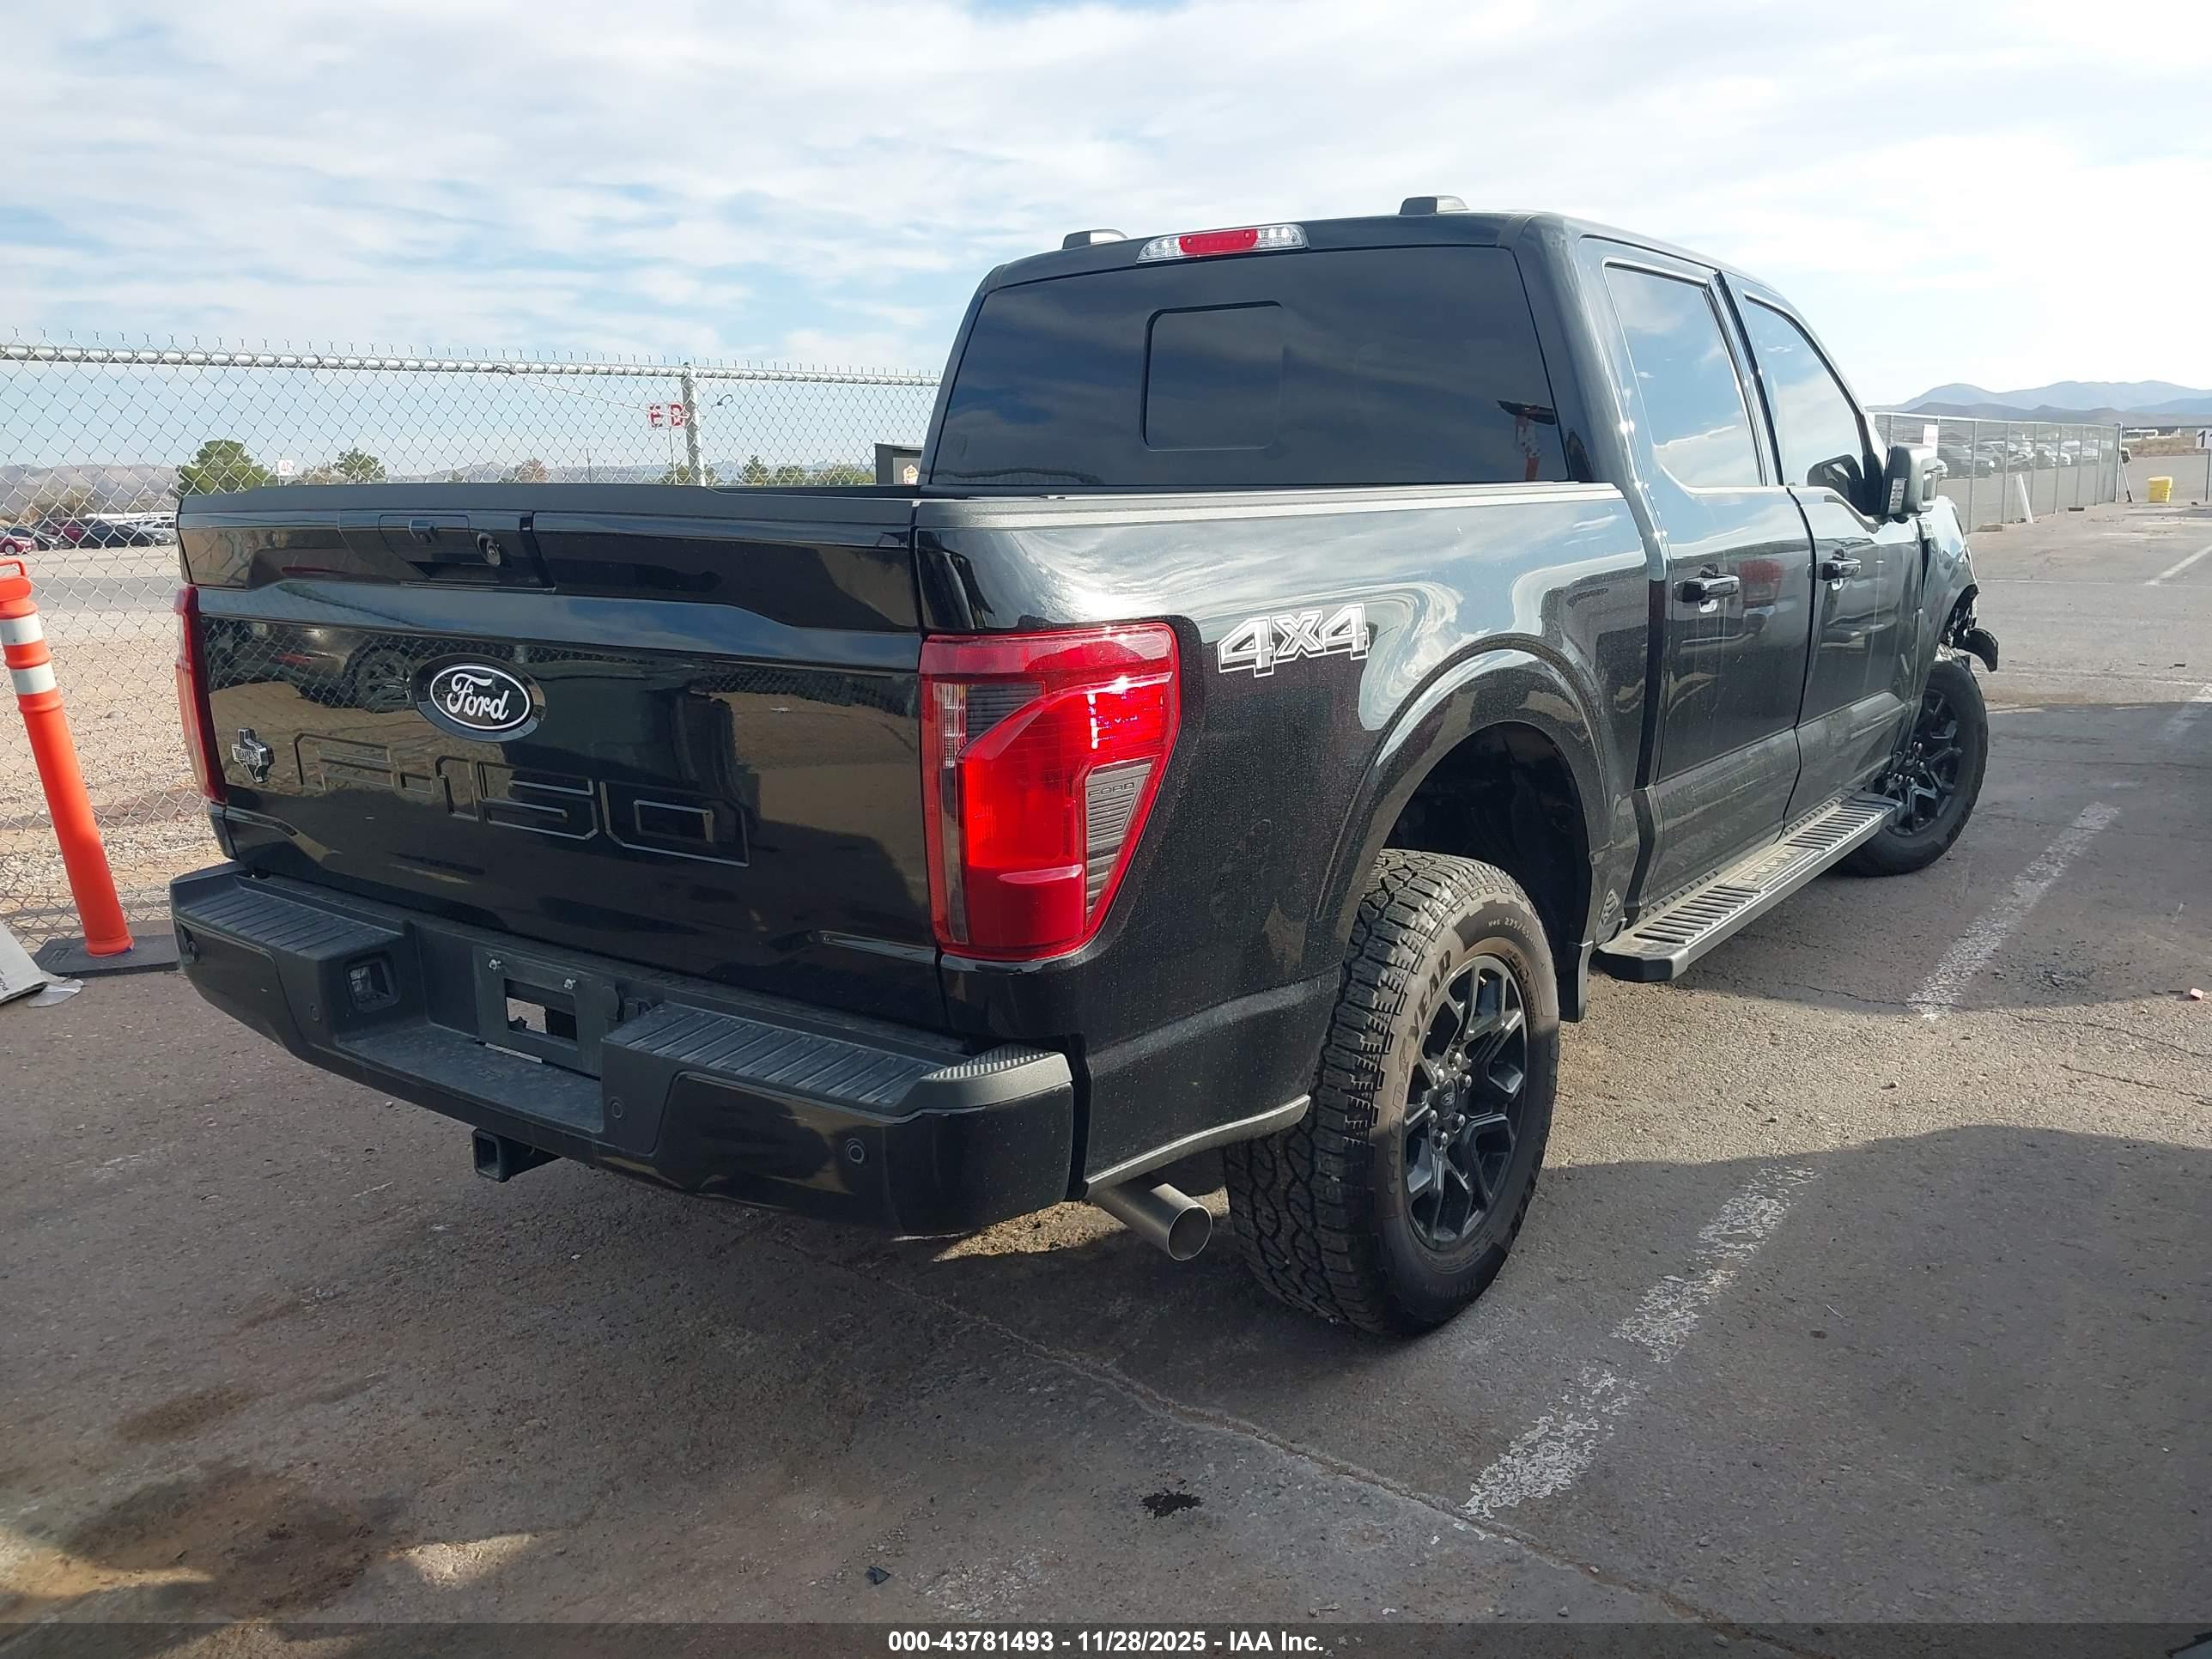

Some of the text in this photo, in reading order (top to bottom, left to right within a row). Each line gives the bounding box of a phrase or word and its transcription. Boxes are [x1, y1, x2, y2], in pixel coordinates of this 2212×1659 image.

[2197, 429, 2212, 447] 1
[446, 672, 510, 721] Ford
[1087, 781, 1135, 798] FORD
